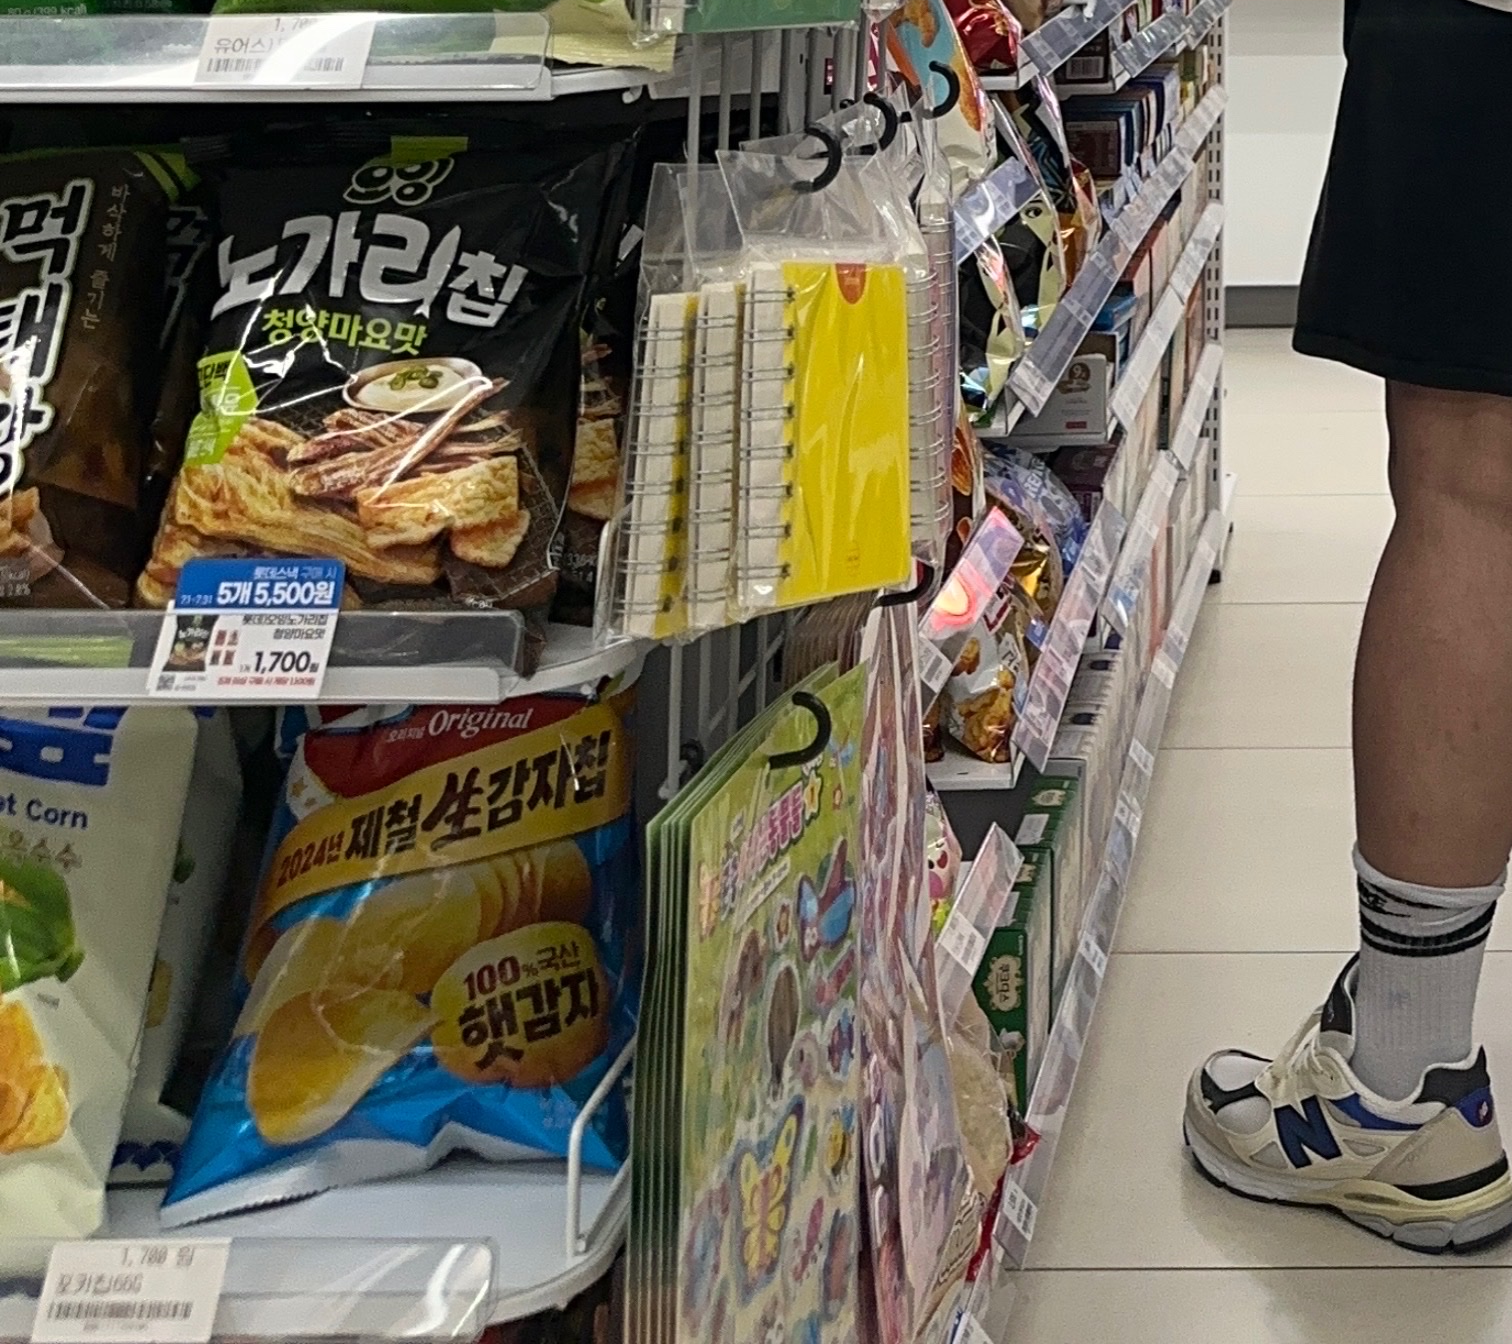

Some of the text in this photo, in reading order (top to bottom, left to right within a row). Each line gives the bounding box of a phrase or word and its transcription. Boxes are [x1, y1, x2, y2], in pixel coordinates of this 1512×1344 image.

[210, 211, 529, 328] 노가리칩
[261, 308, 428, 356] 청양마요맛
[217, 580, 335, 607] 5개 5,500원
[253, 651, 319, 675] 1,700원
[428, 707, 534, 740] Original
[27, 796, 90, 832] Corn
[276, 831, 345, 889] 2024년
[344, 792, 423, 863] 제철
[457, 967, 600, 1072] 햇감자
[1273, 1095, 1343, 1170] N
